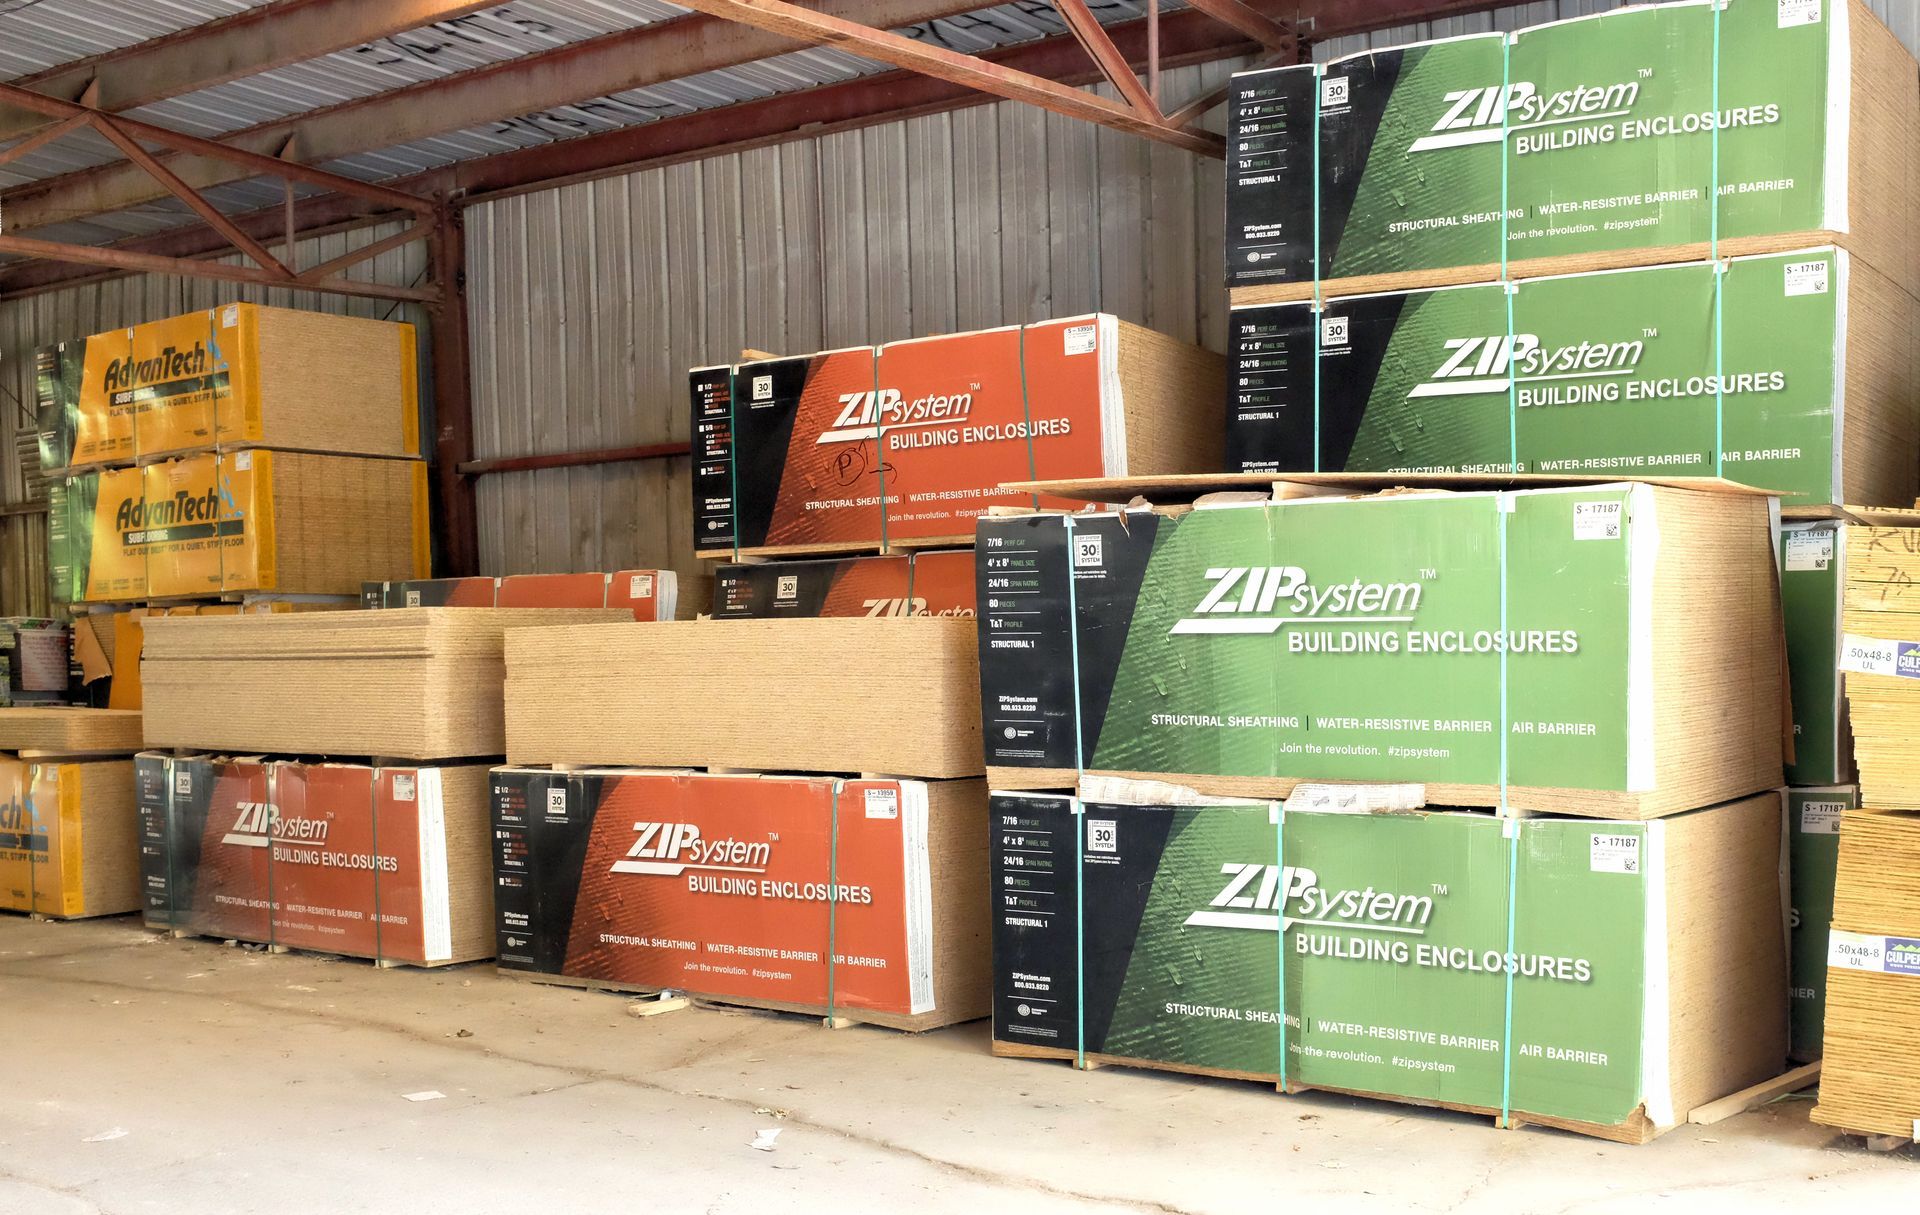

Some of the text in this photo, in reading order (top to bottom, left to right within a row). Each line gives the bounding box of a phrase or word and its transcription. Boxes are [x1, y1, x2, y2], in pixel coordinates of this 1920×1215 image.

[1240, 90, 1255, 99] 7/16
[1328, 86, 1343, 97] 30
[1240, 124, 1259, 133] 24/16
[1516, 104, 1780, 155] BUILDING ENCLOSURES
[1239, 143, 1248, 151] 80
[1239, 160, 1252, 168] T&T
[1239, 175, 1275, 186] STRUCTURAL
[1389, 215, 1459, 233] STRUCTURAL
[1539, 194, 1642, 216] WATER-RESISTIVE
[1644, 188, 1699, 205] BARRIER
[1716, 182, 1736, 198] AIR
[1738, 178, 1794, 195] BARRIER
[1507, 216, 1659, 241] Join the revolution. #zipsystem
[1787, 263, 1825, 274] S 17187
[1241, 325, 1256, 334] 7/16
[1328, 325, 1343, 336] 30
[104, 341, 205, 393] AdvanTech
[1240, 360, 1259, 368] 24/16
[758, 383, 768, 392] 30
[1239, 378, 1248, 386] 80
[1518, 371, 1784, 408] BUILDING ENCLOSURES
[1239, 395, 1251, 403] T&T
[1238, 412, 1274, 421] STRUCTURAL
[890, 418, 1070, 450] BUILDING ENCLOSURES
[1541, 456, 1646, 471] WATER-RESISTIVE
[1648, 453, 1702, 466] BARRIER
[1720, 450, 1741, 463] AIR
[1744, 448, 1801, 461] BARRIER
[806, 498, 855, 510] STRUCTURAL
[909, 488, 981, 502] WATER-RESISTIVE
[116, 487, 219, 533] AdvanTech
[1576, 504, 1619, 514] S 17187
[888, 512, 901, 522] Join
[903, 512, 914, 521] the
[225, 538, 244, 547] FLOOR
[987, 538, 1003, 547] 7/16
[1081, 544, 1096, 556] 30
[783, 582, 793, 592] 30
[988, 579, 1008, 588] 24/16
[410, 597, 418, 605] 30
[989, 599, 998, 608] 80
[990, 619, 1003, 628] T&T
[991, 640, 1035, 648] STRUCTURAL 1
[1288, 630, 1578, 653] BUILDING ENCLOSURES
[1848, 647, 1892, 662] .50x48-8
[1862, 661, 1875, 670] UL
[1151, 714, 1596, 736] STRUCTURAL SHEATHING WATER-RESISTIVE BARRIER AIR BARRIER
[1280, 742, 1450, 760] Join the revolution. #zipsystem
[179, 779, 188, 787] 30
[552, 796, 562, 805] 30
[1805, 803, 1844, 812] S 17187
[1002, 816, 1018, 825] 7/16
[1095, 830, 1111, 841] 30
[1593, 836, 1636, 847] S 17187
[273, 847, 398, 872] BUILDING ENCLOSURES
[1004, 856, 1024, 866] 24/16
[1004, 876, 1013, 885] 80
[688, 875, 871, 904] BUILDING ENCLOSURES
[1005, 896, 1018, 905] T&T
[215, 895, 408, 926] STRUCTURAL WATER-RESISTIVE BARRIER BARRIER
[1005, 917, 1048, 928] STRUCTURAL 1
[600, 933, 887, 968] STRUCTURAL SHEATHING WATER-RESISTIVE BARRIER BARRIER
[1835, 944, 1879, 957] .50x48-8
[1296, 933, 1591, 982] BUILDING ENCLOSURES
[1850, 958, 1863, 966] UL
[683, 961, 792, 980] Join the revolution. #zipsystem
[1165, 1002, 1242, 1021] STRUCTURAL
[1318, 1020, 1436, 1045] WATER-RESISTIVE
[1440, 1034, 1499, 1052] BARRIER
[1519, 1043, 1542, 1057] AIR
[1546, 1046, 1608, 1066] BARRIER
[1304, 1046, 1323, 1057] the
[1326, 1048, 1385, 1065] revolution.
[1391, 1055, 1456, 1074] #zipsystem
